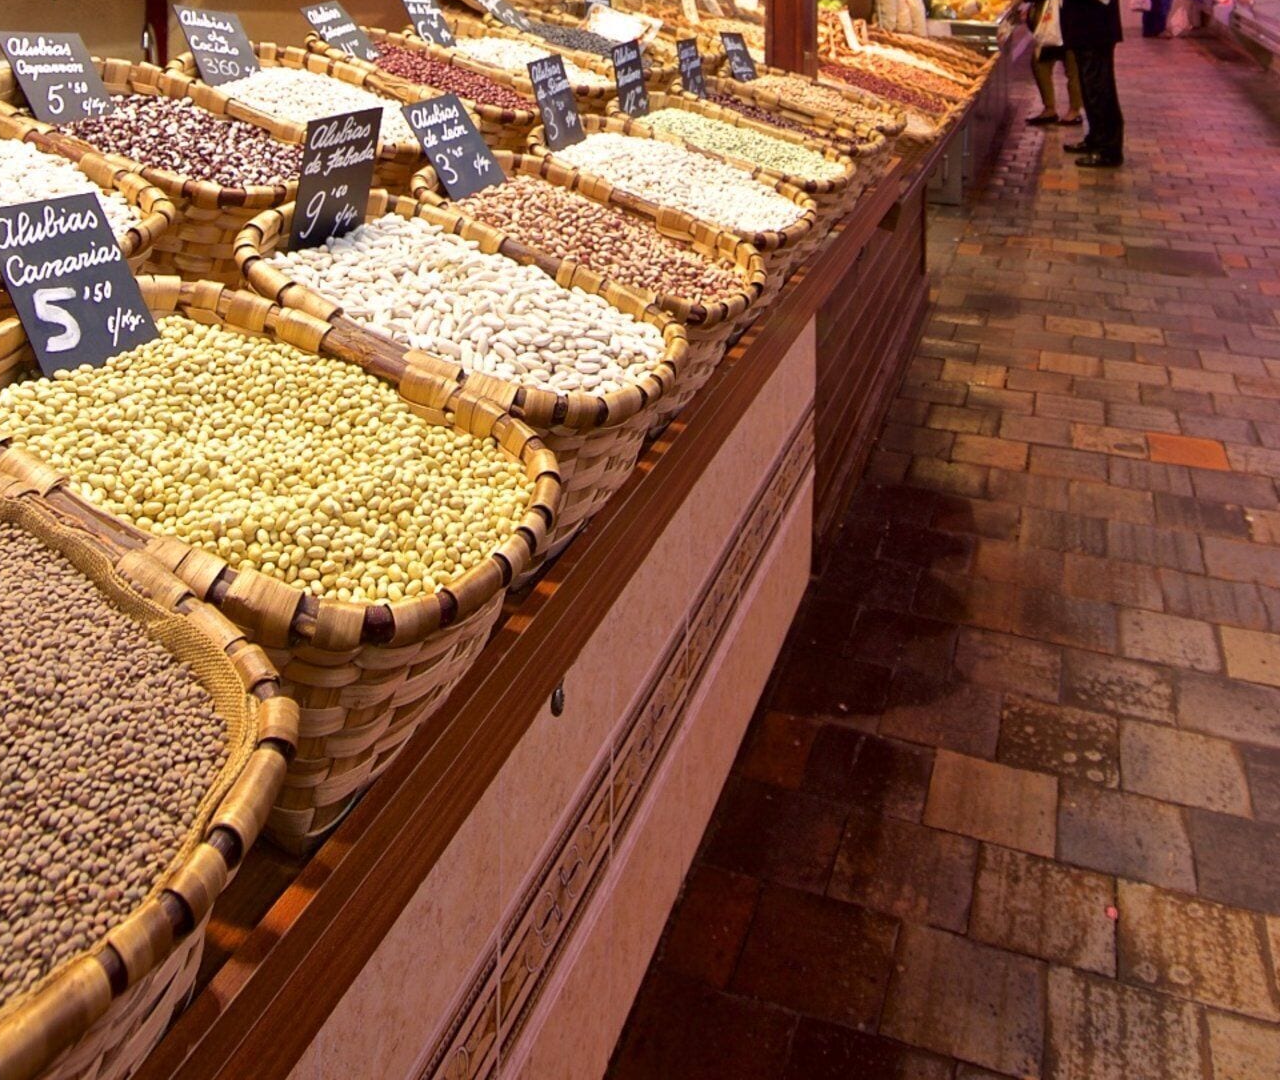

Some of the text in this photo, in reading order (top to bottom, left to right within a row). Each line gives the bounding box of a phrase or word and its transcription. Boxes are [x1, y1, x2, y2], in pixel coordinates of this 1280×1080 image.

[180, 9, 235, 33] Alubias
[6, 34, 72, 56] Alubias
[190, 35, 240, 56] Cocido
[410, 103, 460, 130] Alubias
[309, 116, 371, 151] Alubias
[423, 120, 469, 148] de León
[304, 156, 322, 176] de
[6, 241, 122, 287] Canarias
